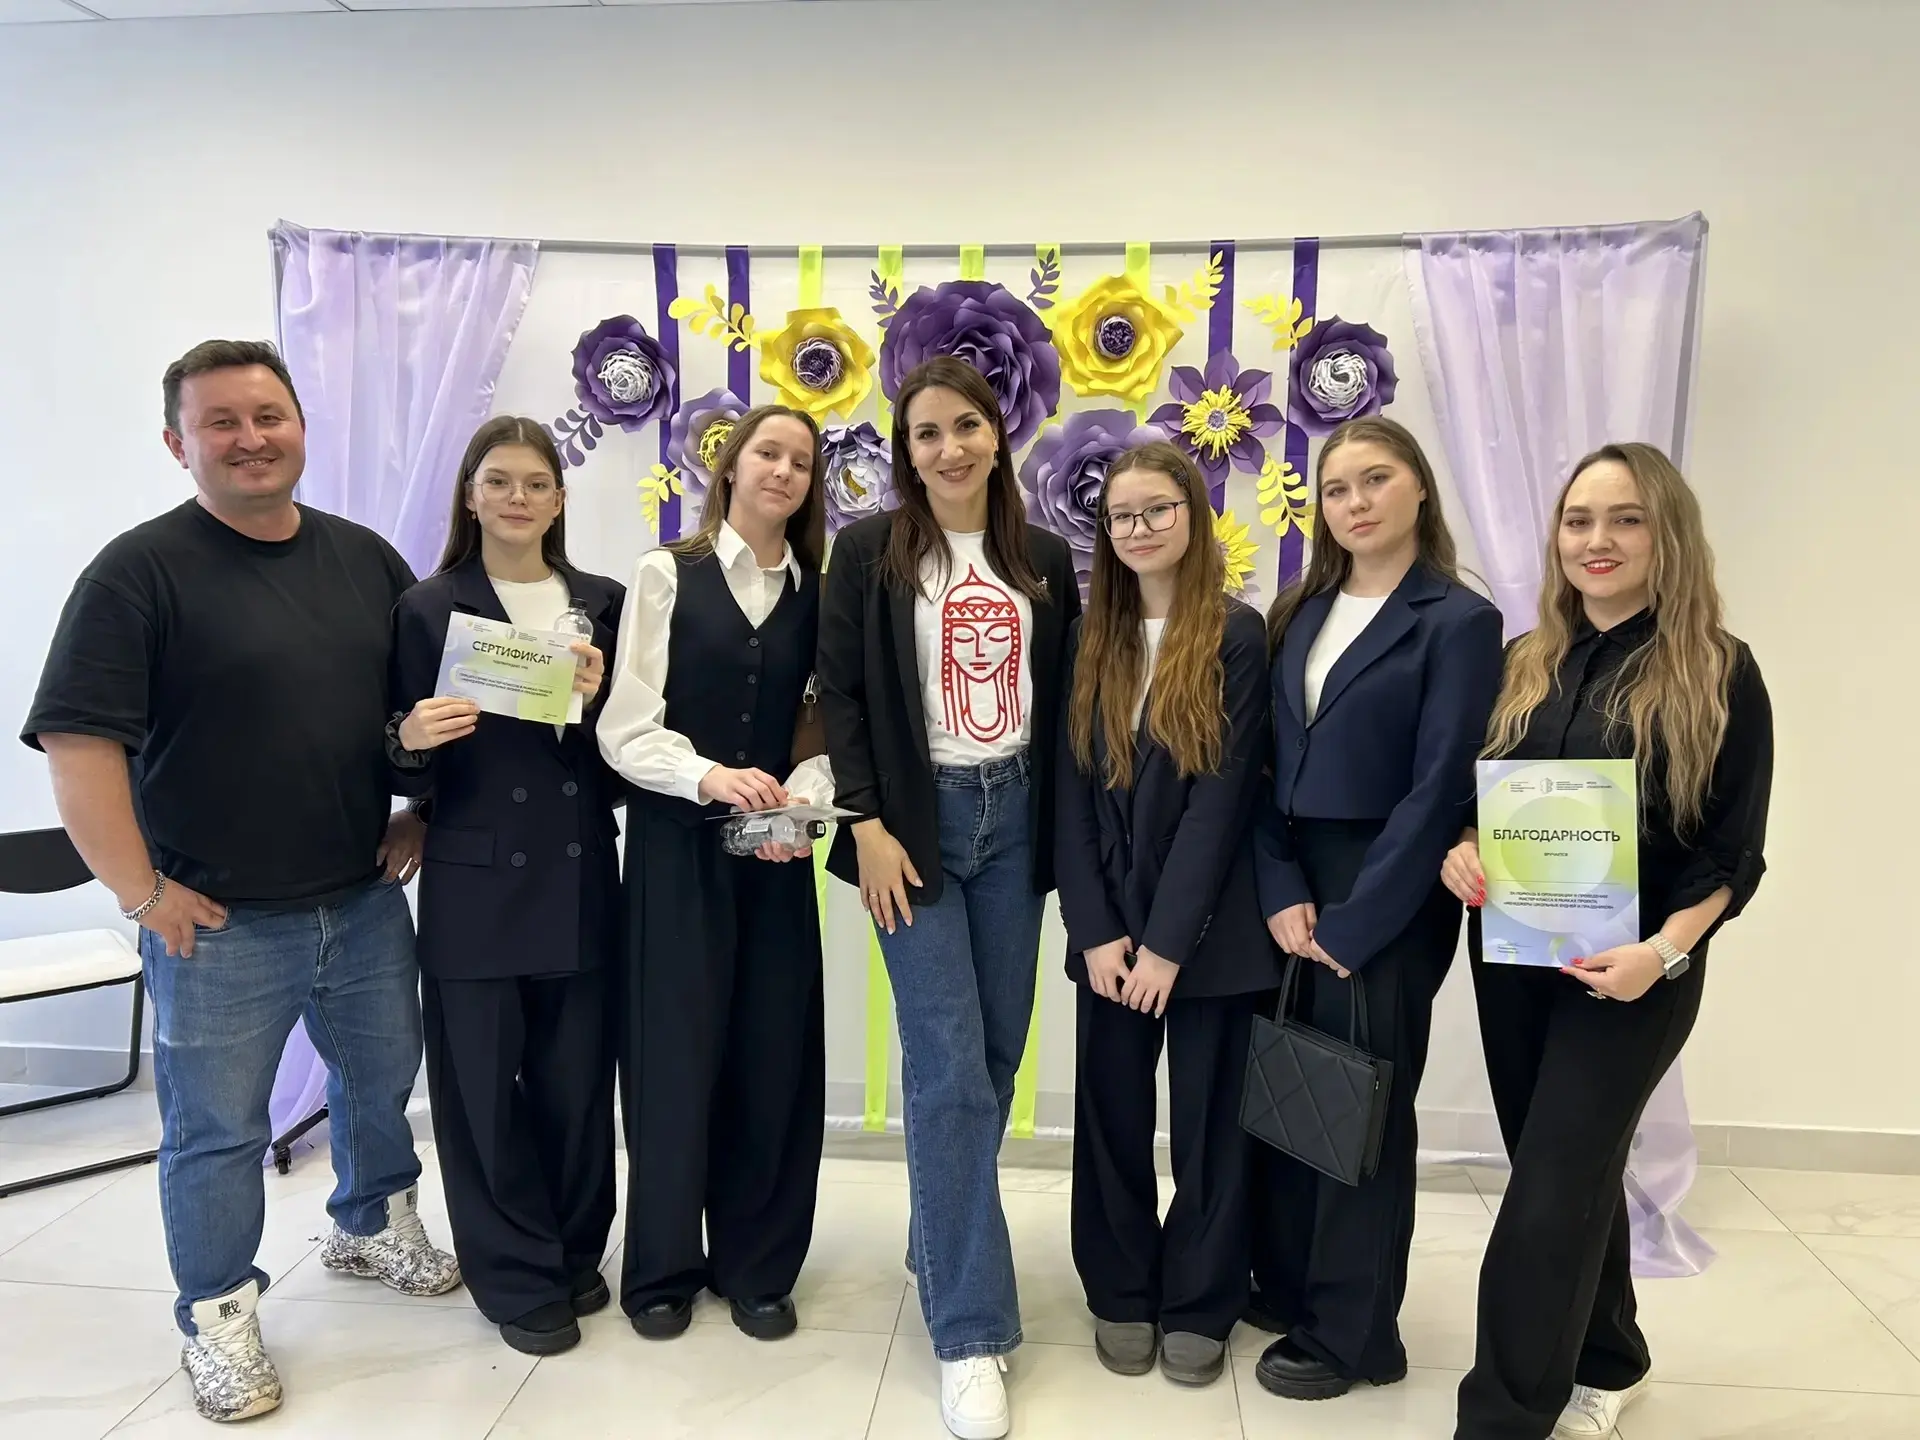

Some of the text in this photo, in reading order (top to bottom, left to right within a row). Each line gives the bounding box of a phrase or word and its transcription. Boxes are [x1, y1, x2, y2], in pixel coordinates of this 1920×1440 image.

[472, 640, 553, 665] СЕРТИФИКАТ
[1493, 829, 1620, 842] БЛАГОДАРНОСТЬ
[218, 1300, 241, 1320] 戰
